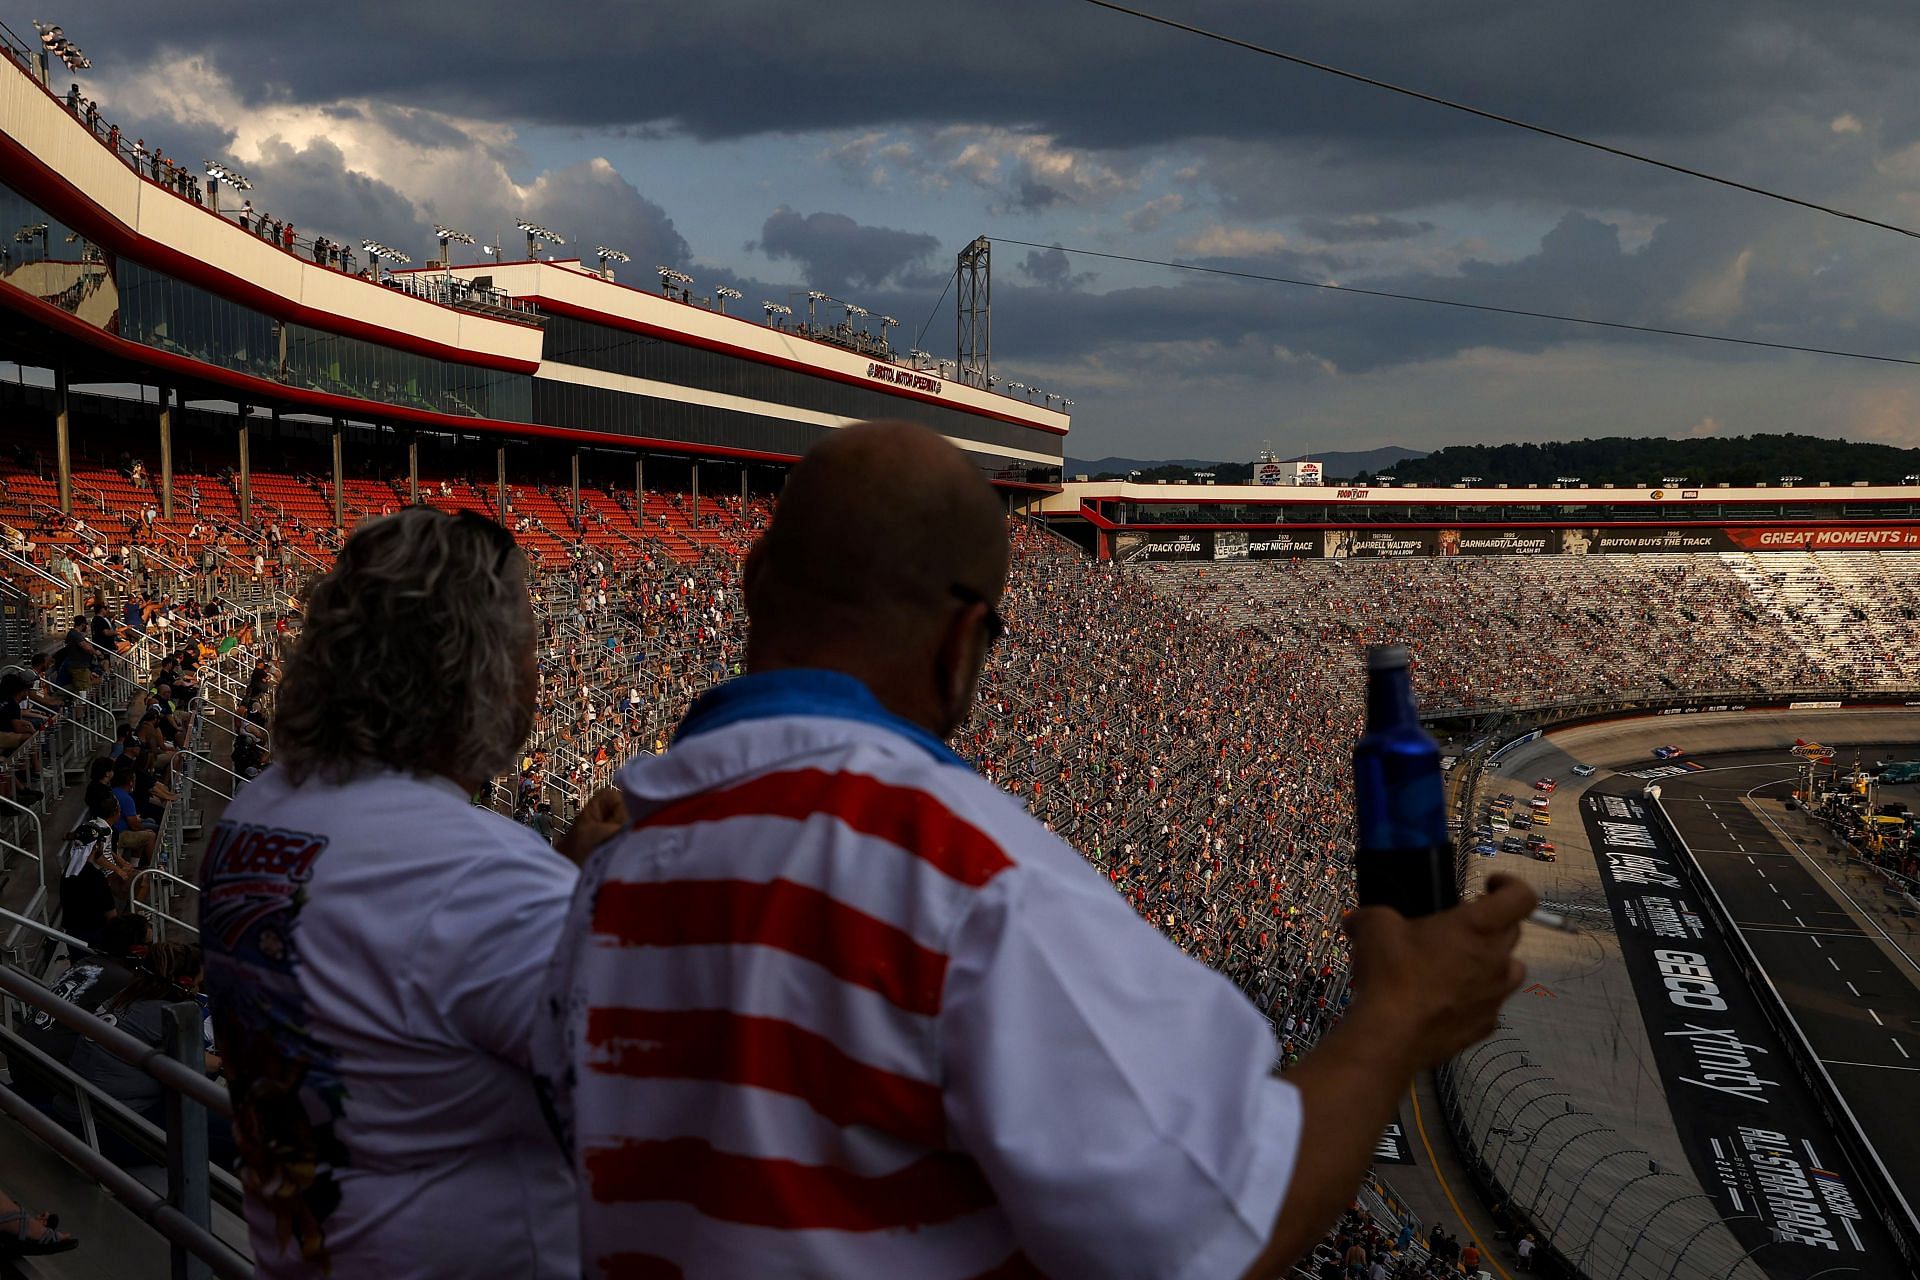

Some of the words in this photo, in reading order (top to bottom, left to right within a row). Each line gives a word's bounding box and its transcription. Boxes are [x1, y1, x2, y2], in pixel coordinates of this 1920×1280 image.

[873, 364, 894, 382] BRISTOL
[895, 370, 913, 387] MOTOR
[1337, 489, 1351, 499] FOOD
[1356, 490, 1369, 499] CITY
[1148, 543, 1173, 552] TRACK
[1174, 543, 1201, 552] OPENS
[1249, 542, 1270, 551] FIRST
[1270, 542, 1293, 551] NIGHT
[1293, 542, 1313, 551] RACE
[1356, 541, 1386, 549] DARRELL
[1387, 541, 1422, 549] WALTRIP'S
[1460, 539, 1546, 548] EARNHARDT/LABONTE
[1600, 538, 1637, 546] BRUTON
[1638, 538, 1661, 546] BUYS
[1663, 537, 1681, 546] THE
[1682, 537, 1712, 546] TRACK
[1760, 532, 1814, 544] GREAT
[1816, 531, 1901, 544] MOMENTS
[1904, 533, 1918, 543] in
[1796, 747, 1833, 756] SUNOCO
[1597, 820, 1657, 849] BUSCH
[1653, 949, 1729, 1011] GEICO
[1737, 1125, 1793, 1154] ALL
[1715, 1159, 1739, 1186] 2020
[1733, 1156, 1755, 1195] BRISTOL
[1749, 1153, 1815, 1199] STAR
[1813, 1177, 1863, 1220] NASCAR
[1765, 1195, 1840, 1251] RACE
